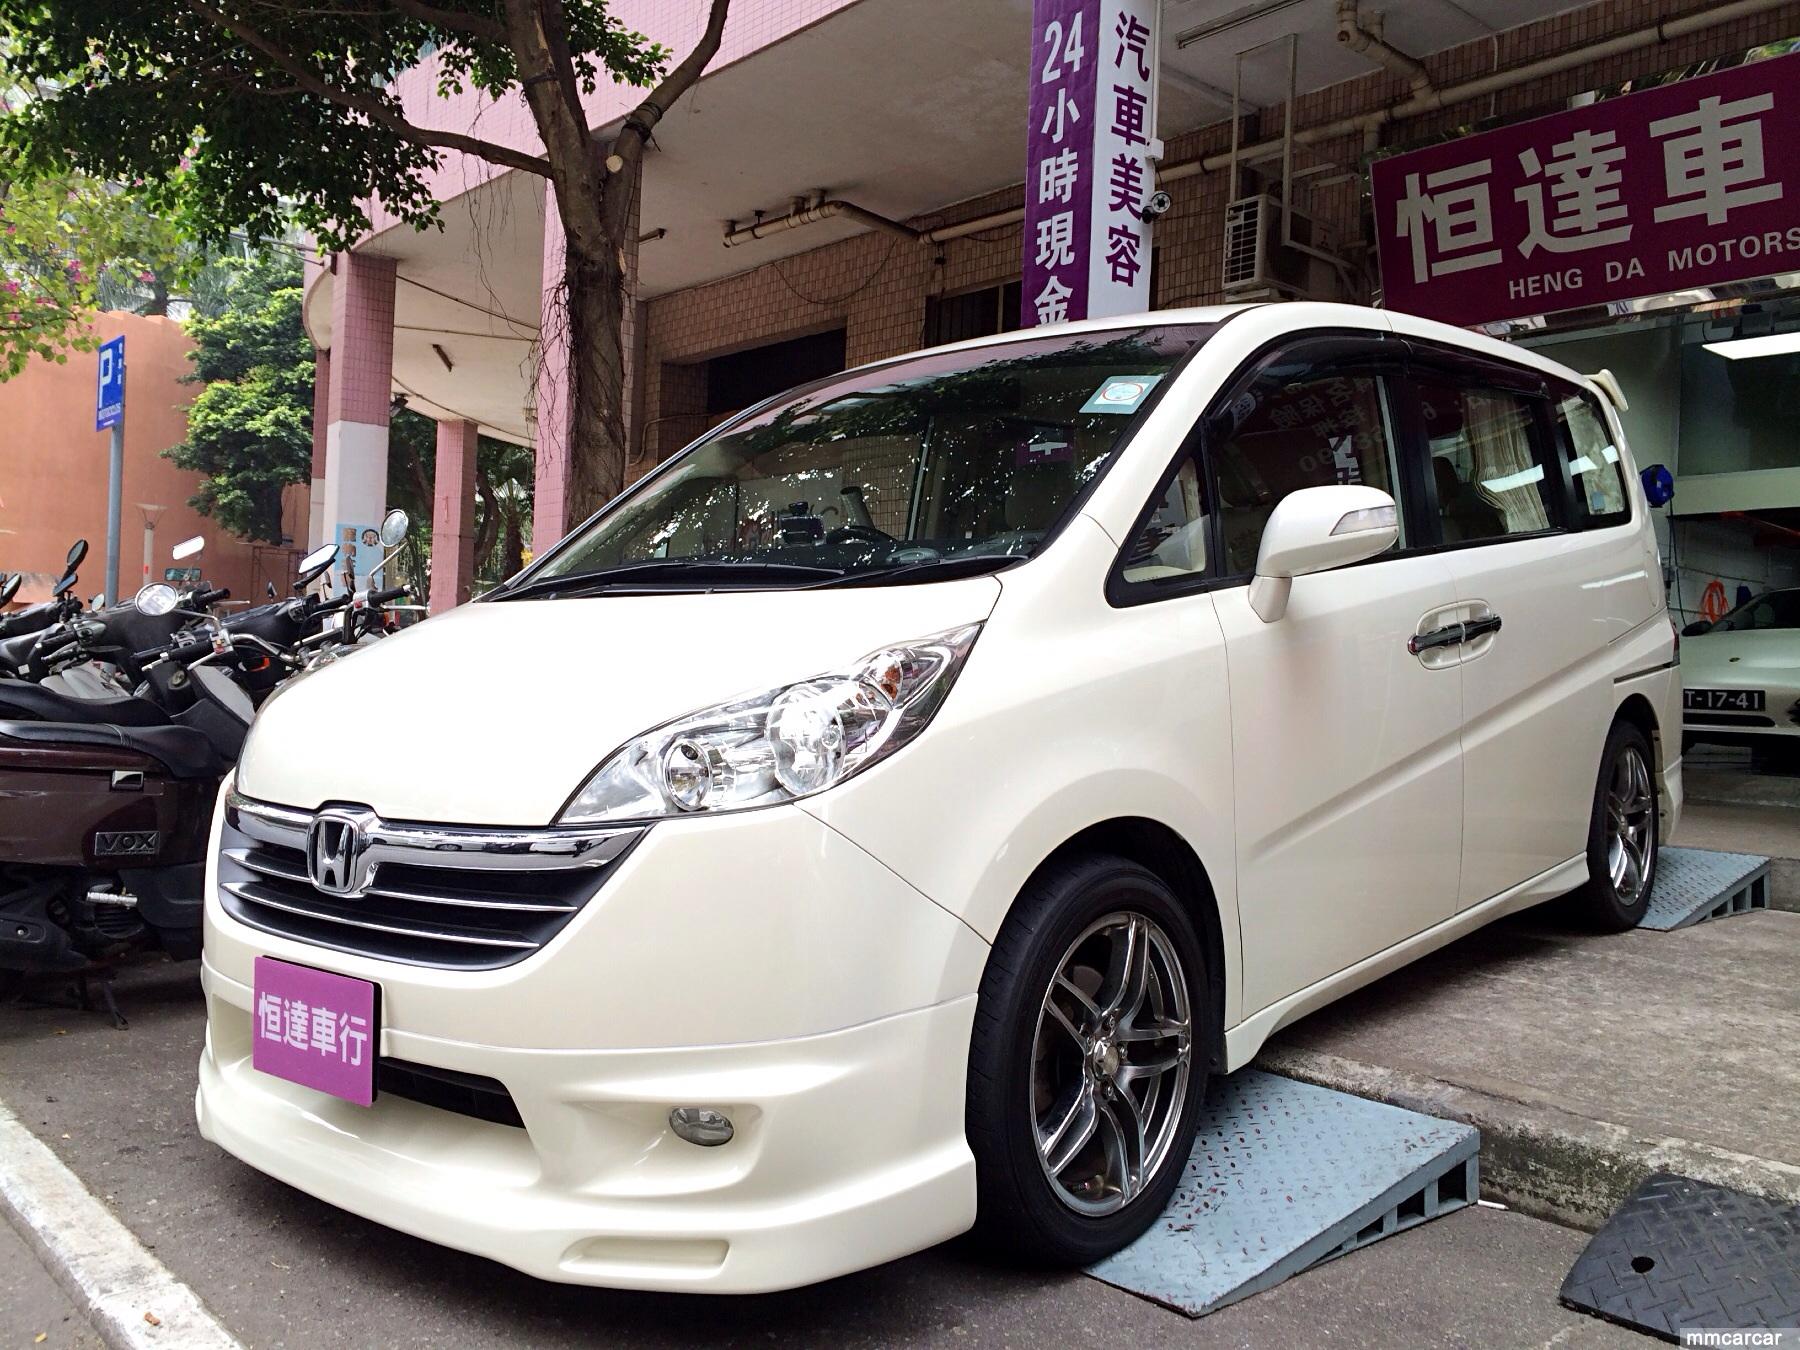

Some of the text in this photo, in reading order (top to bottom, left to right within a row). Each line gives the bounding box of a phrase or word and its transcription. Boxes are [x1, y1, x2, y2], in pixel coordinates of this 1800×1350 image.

[1105, 11, 1150, 288] 汽車美容
[1396, 92, 1783, 284] 恒達車
[1508, 227, 1800, 299] HENG DA MOTORS
[99, 348, 112, 409] P
[101, 832, 157, 851] VOX
[259, 991, 367, 1066] 恒達車行
